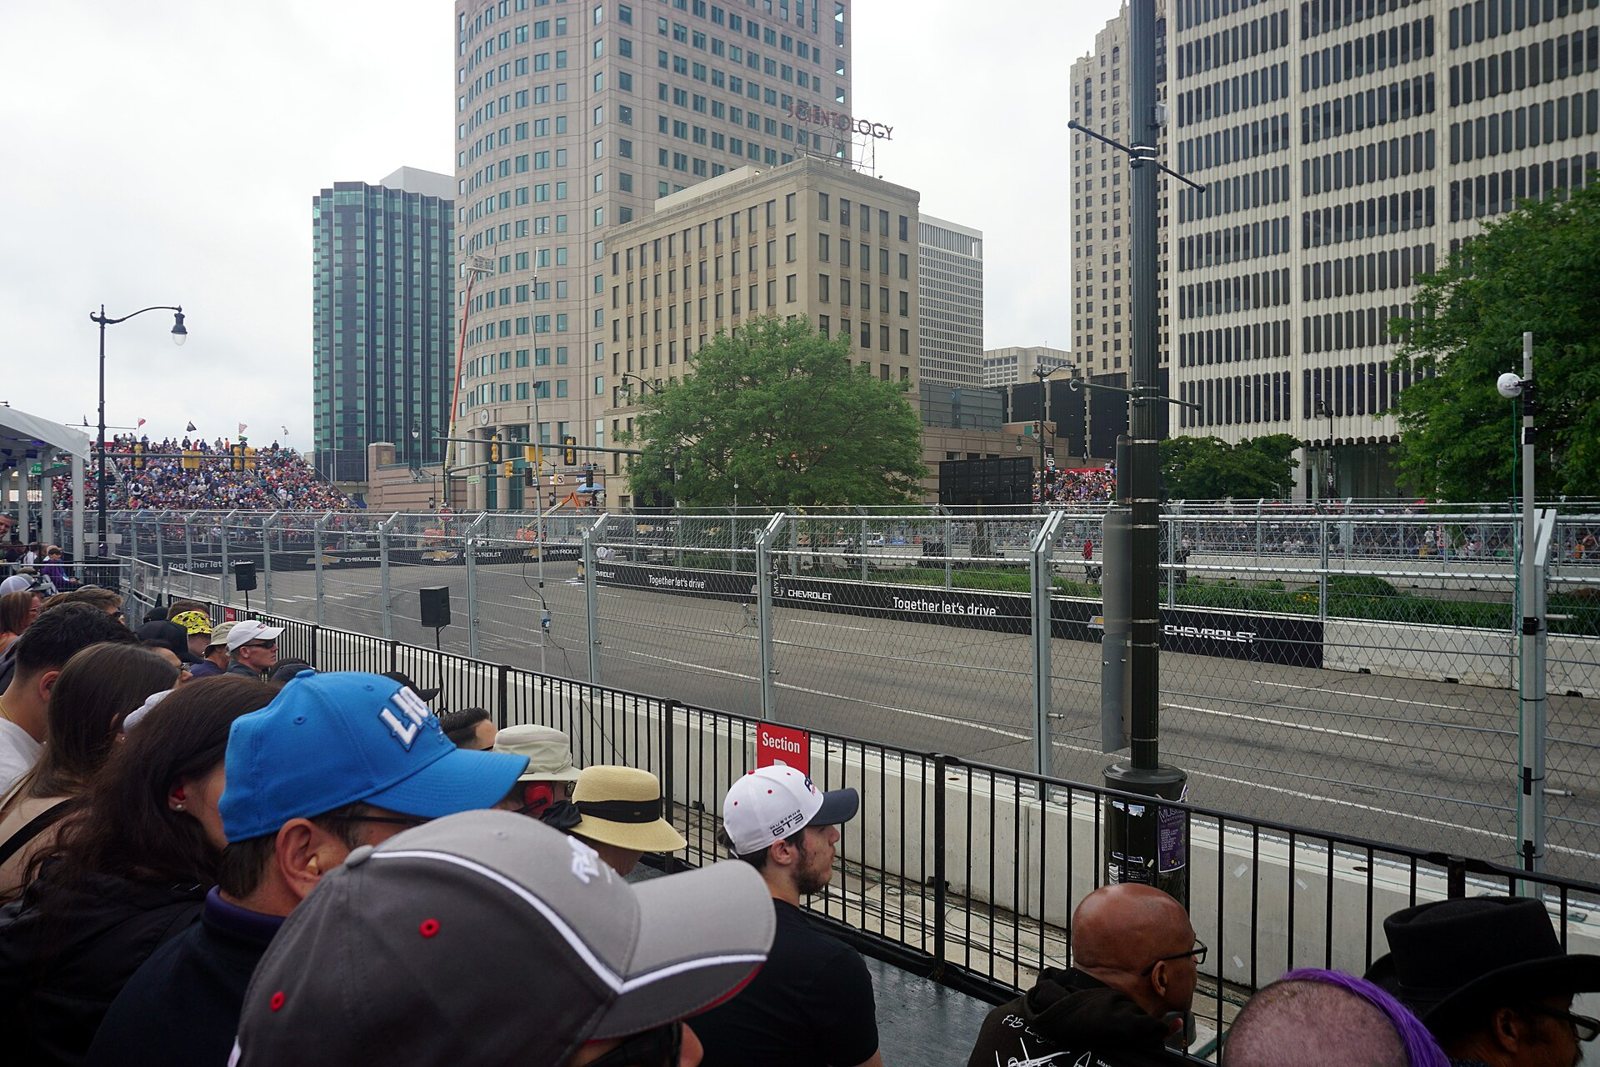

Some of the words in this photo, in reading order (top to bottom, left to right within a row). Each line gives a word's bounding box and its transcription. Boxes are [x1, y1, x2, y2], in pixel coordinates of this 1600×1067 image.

[787, 101, 894, 141] SCIENTOLOGY
[648, 574, 675, 586] Together
[787, 589, 832, 601] CHEVROLET
[892, 596, 940, 611] Together
[941, 600, 965, 614] let's
[1163, 624, 1257, 644] CHEVROLET
[762, 731, 801, 754] Section
[772, 812, 804, 837] GT3
